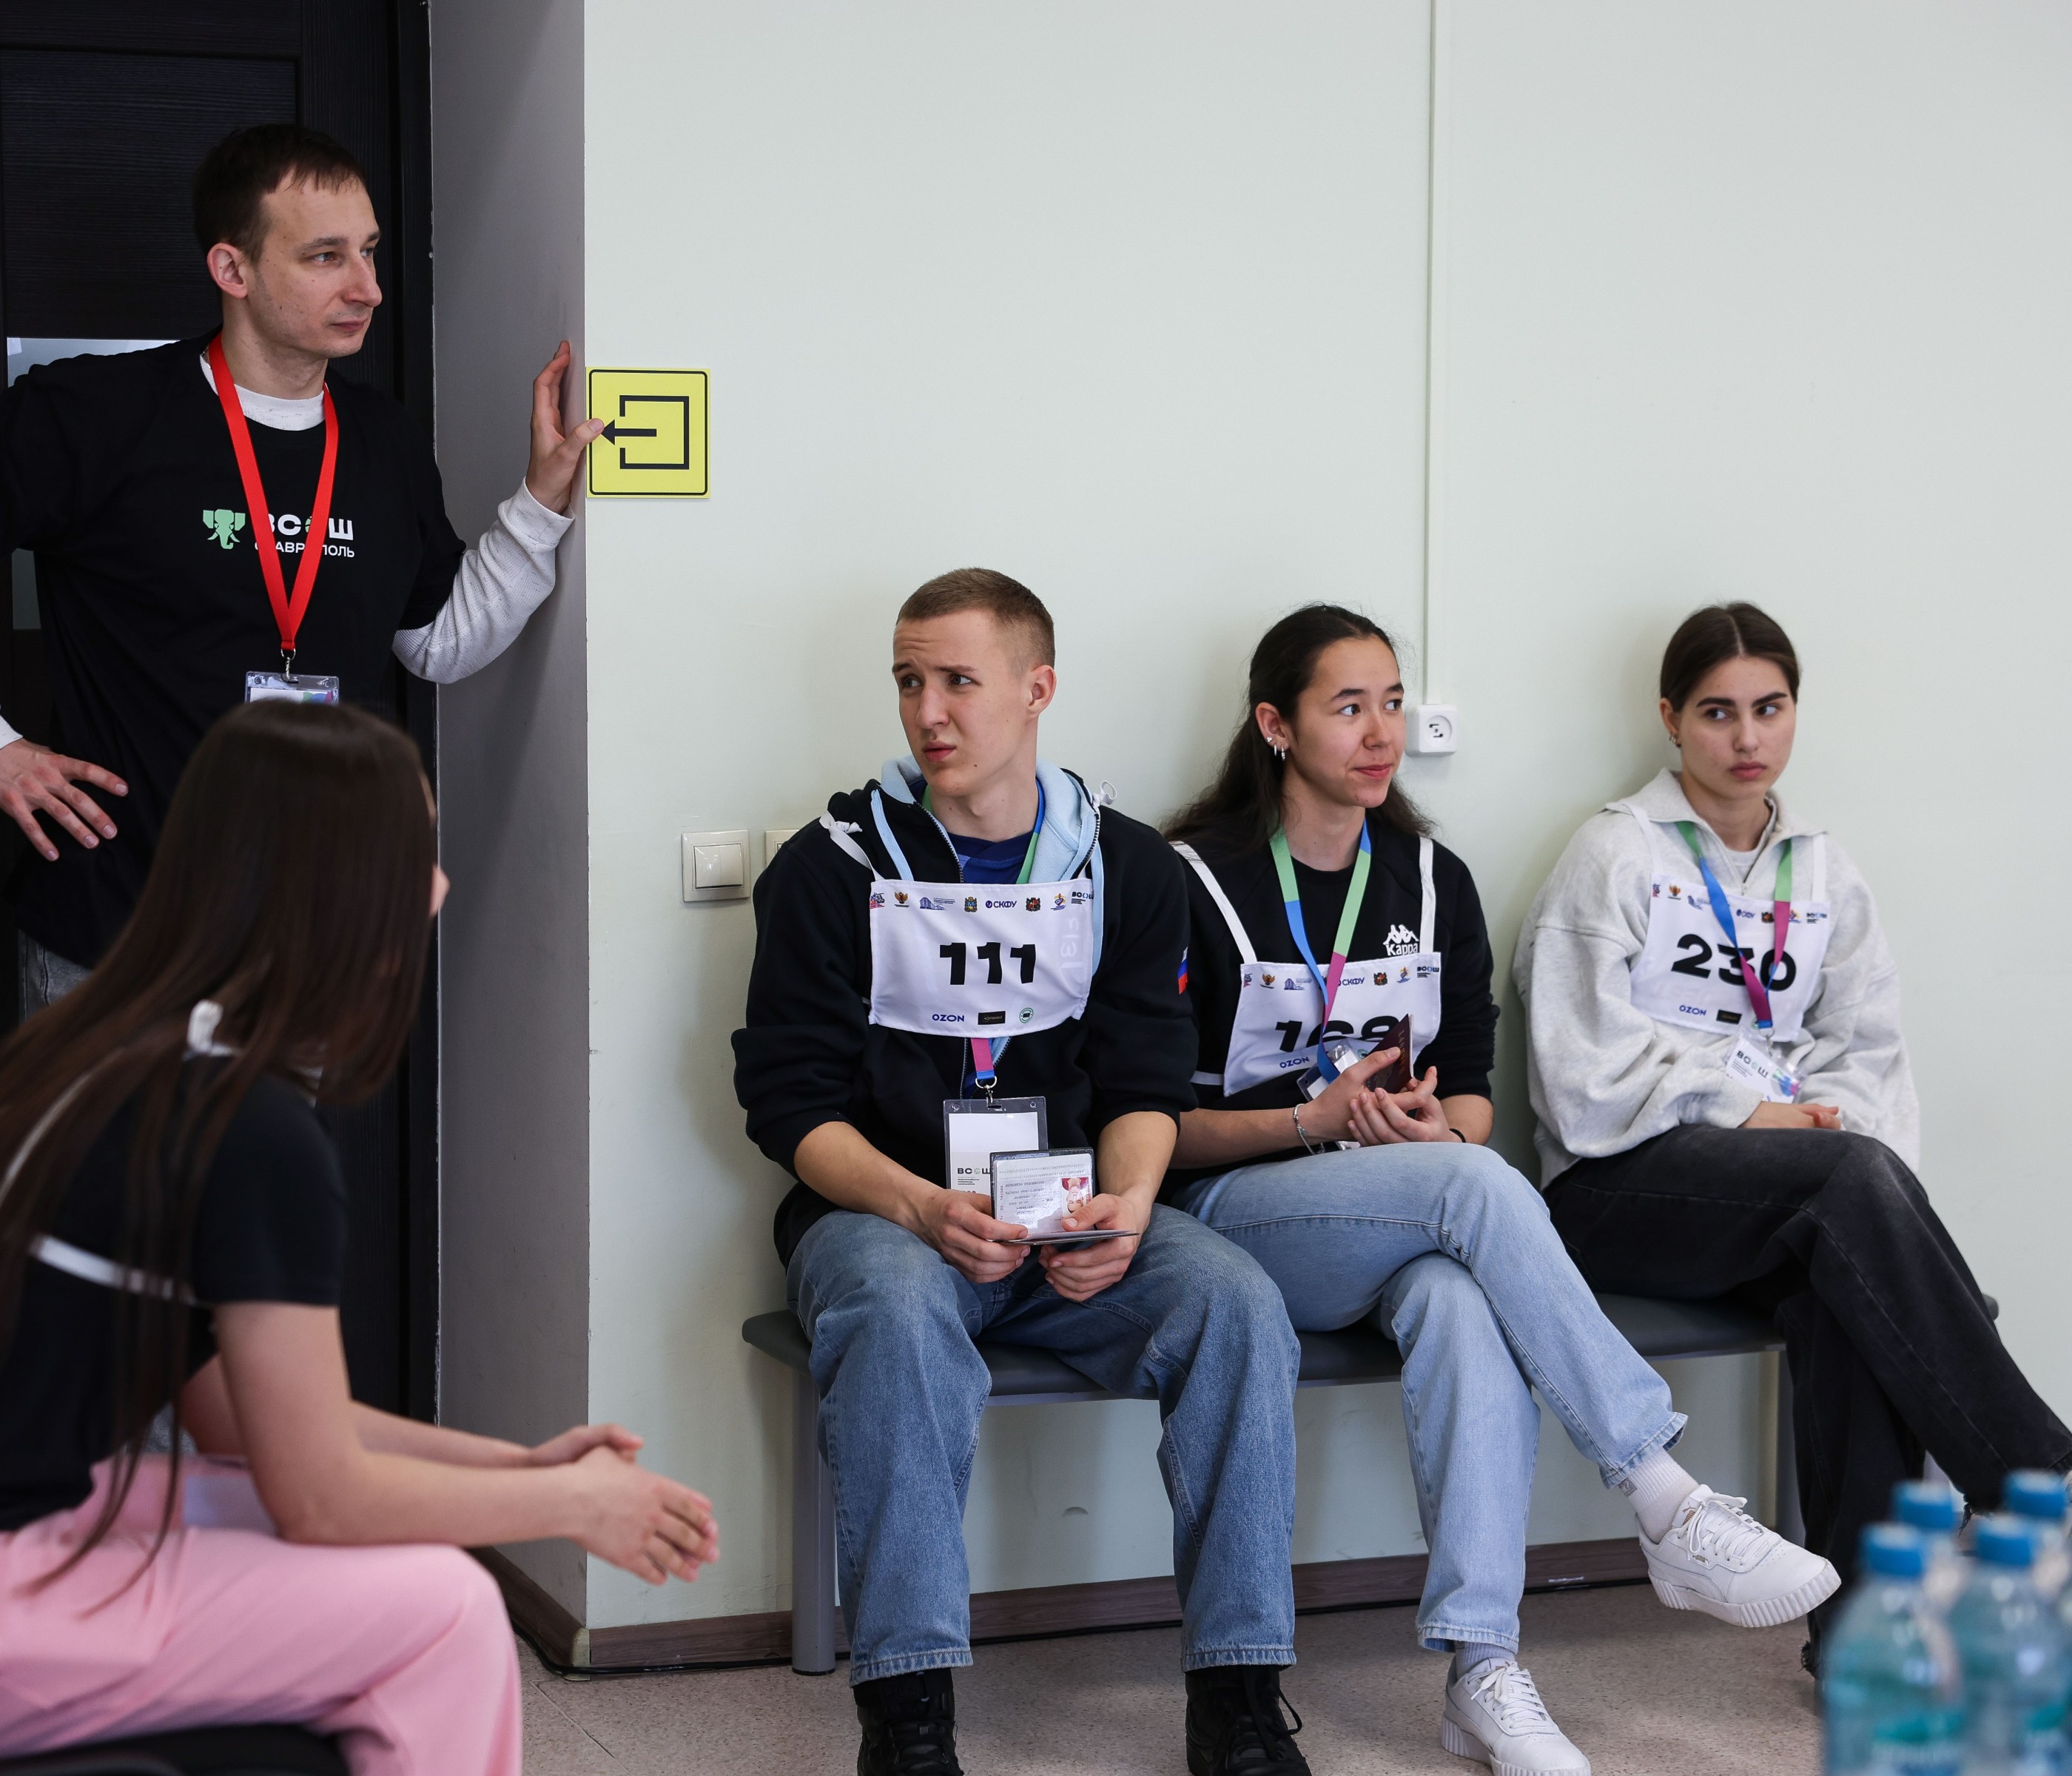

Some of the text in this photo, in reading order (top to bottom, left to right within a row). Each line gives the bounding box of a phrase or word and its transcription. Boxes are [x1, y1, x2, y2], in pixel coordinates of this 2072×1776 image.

[268, 514, 354, 541] СШ
[255, 542, 355, 558] АВРПОЛЬ
[1385, 943, 1419, 956] Kappa
[939, 942, 1036, 985] 111
[1671, 933, 1797, 992] 230
[1679, 1005, 1706, 1016] OZON
[932, 1014, 964, 1022] OZON
[1279, 1057, 1310, 1069] OZON
